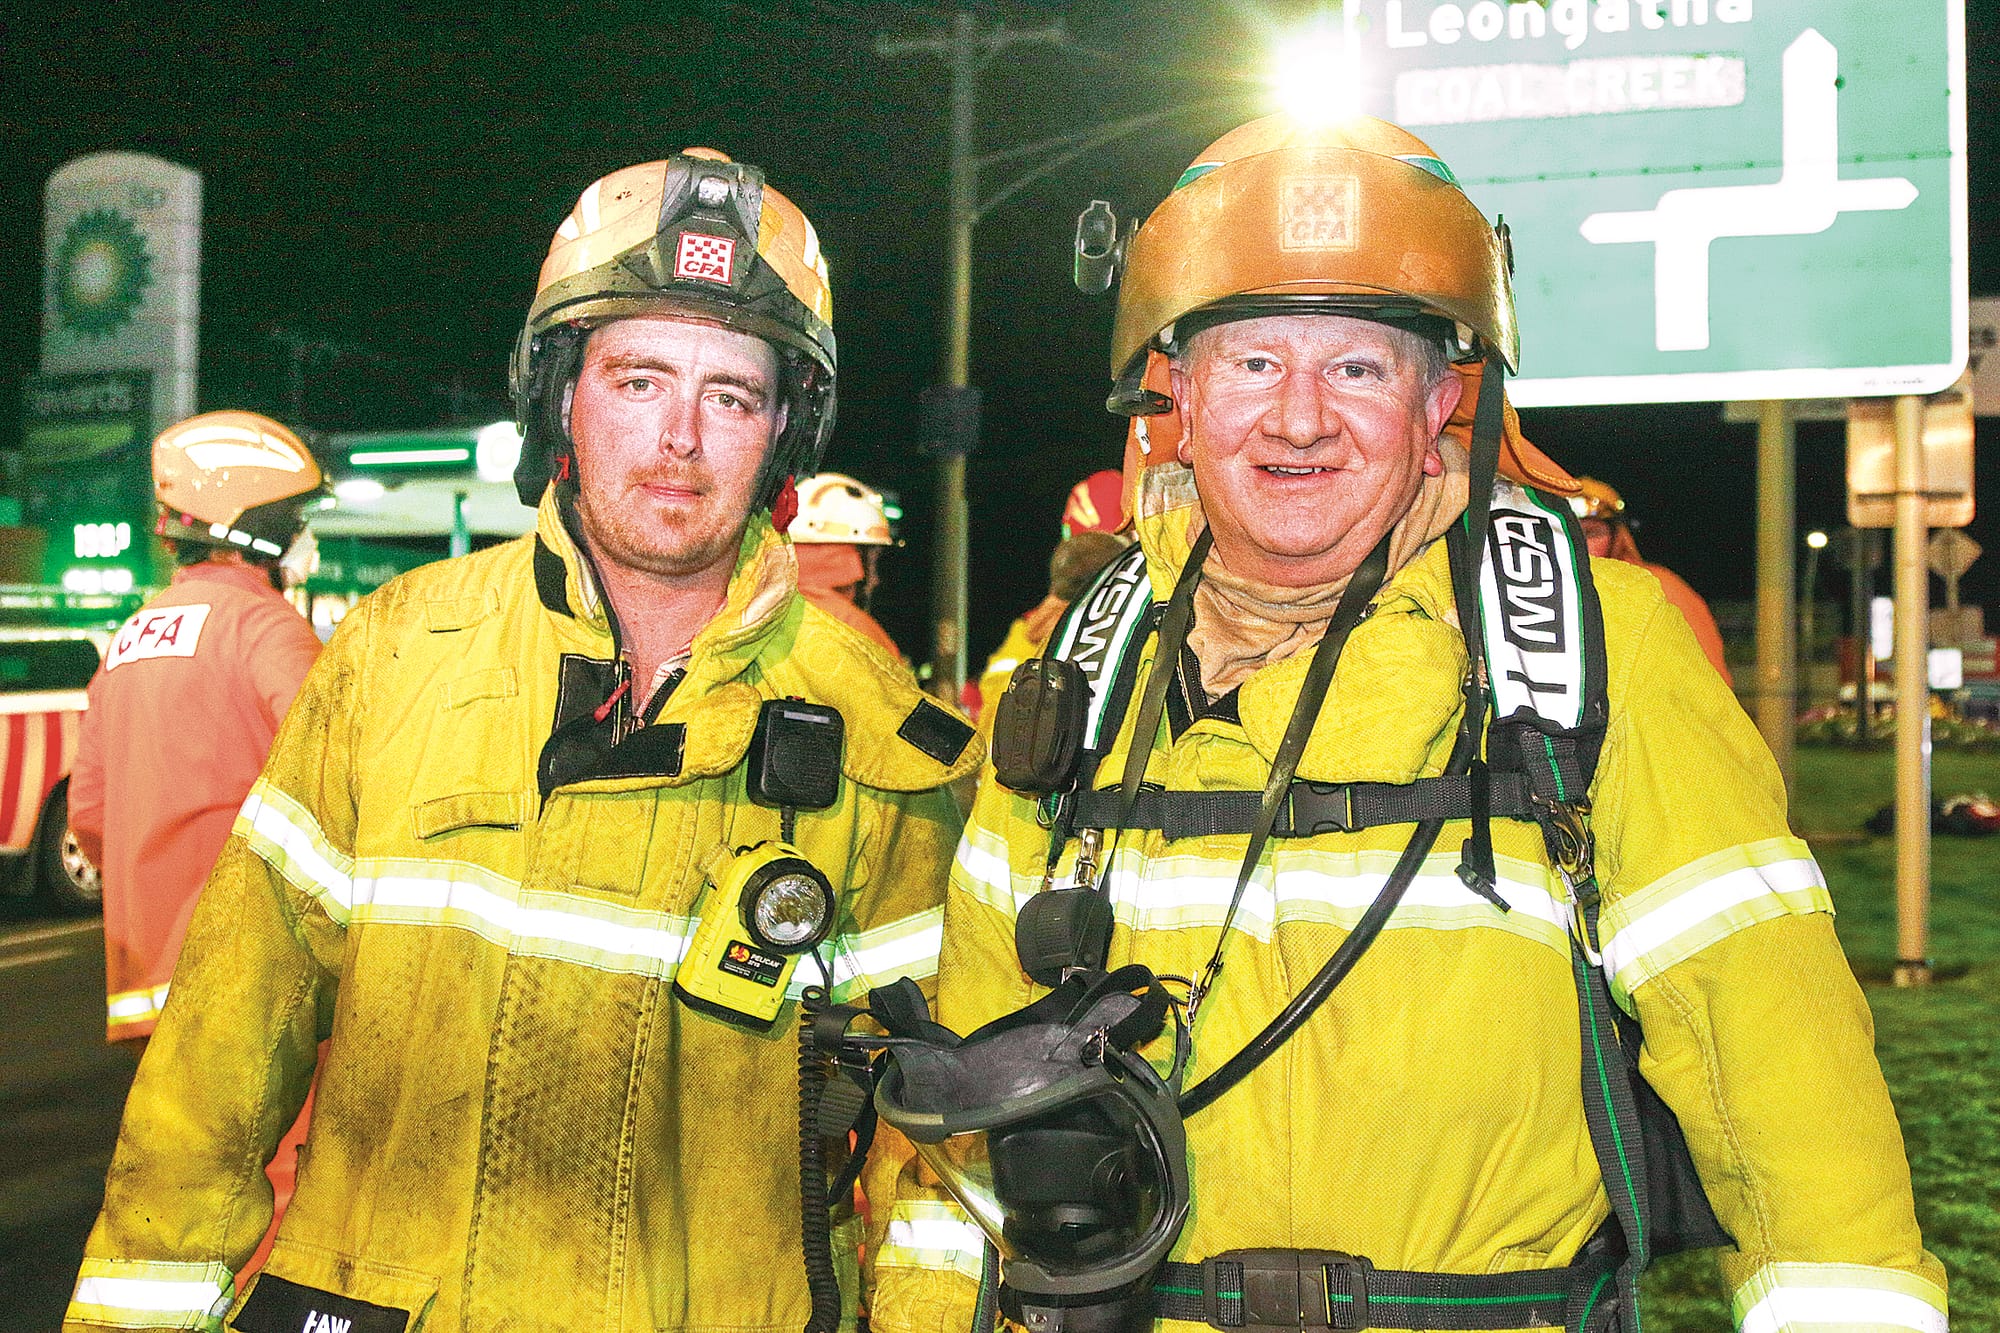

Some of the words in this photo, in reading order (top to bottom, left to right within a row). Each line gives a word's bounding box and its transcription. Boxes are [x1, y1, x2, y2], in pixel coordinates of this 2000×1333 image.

[1409, 67, 1536, 118] COAL
[1563, 56, 1726, 108] CREEK
[1291, 220, 1348, 241] CFA
[683, 260, 725, 278] CFA
[1493, 516, 1558, 644] MSA
[118, 613, 185, 656] CFA
[750, 953, 781, 968] PELICAN
